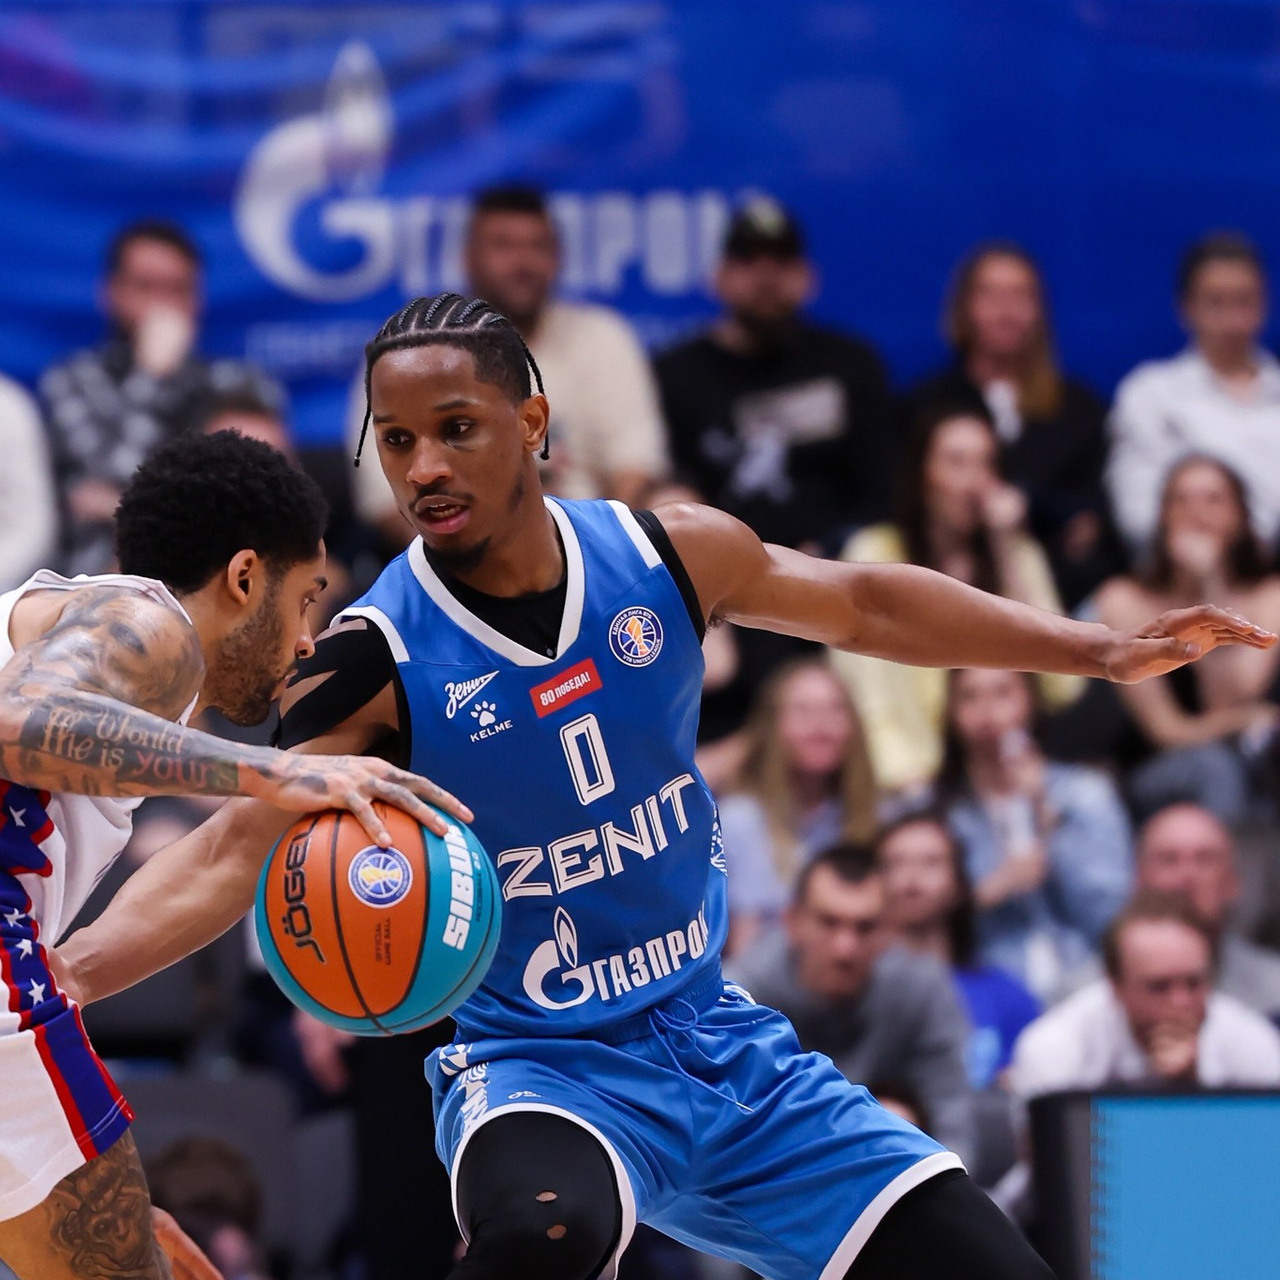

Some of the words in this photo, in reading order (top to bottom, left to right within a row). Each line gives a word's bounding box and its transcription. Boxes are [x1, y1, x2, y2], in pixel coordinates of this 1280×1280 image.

[622, 654, 632, 663] VTB
[632, 656, 651, 664] UNITED
[651, 639, 661, 657] LEAGUE
[444, 670, 500, 719] Зенит
[539, 691, 556, 707] 80
[555, 671, 591, 699] ПОБЕДА!
[470, 719, 513, 743] KELME
[560, 712, 616, 807] 0
[497, 772, 696, 903] ZENIT
[282, 818, 327, 963] JÖGEL
